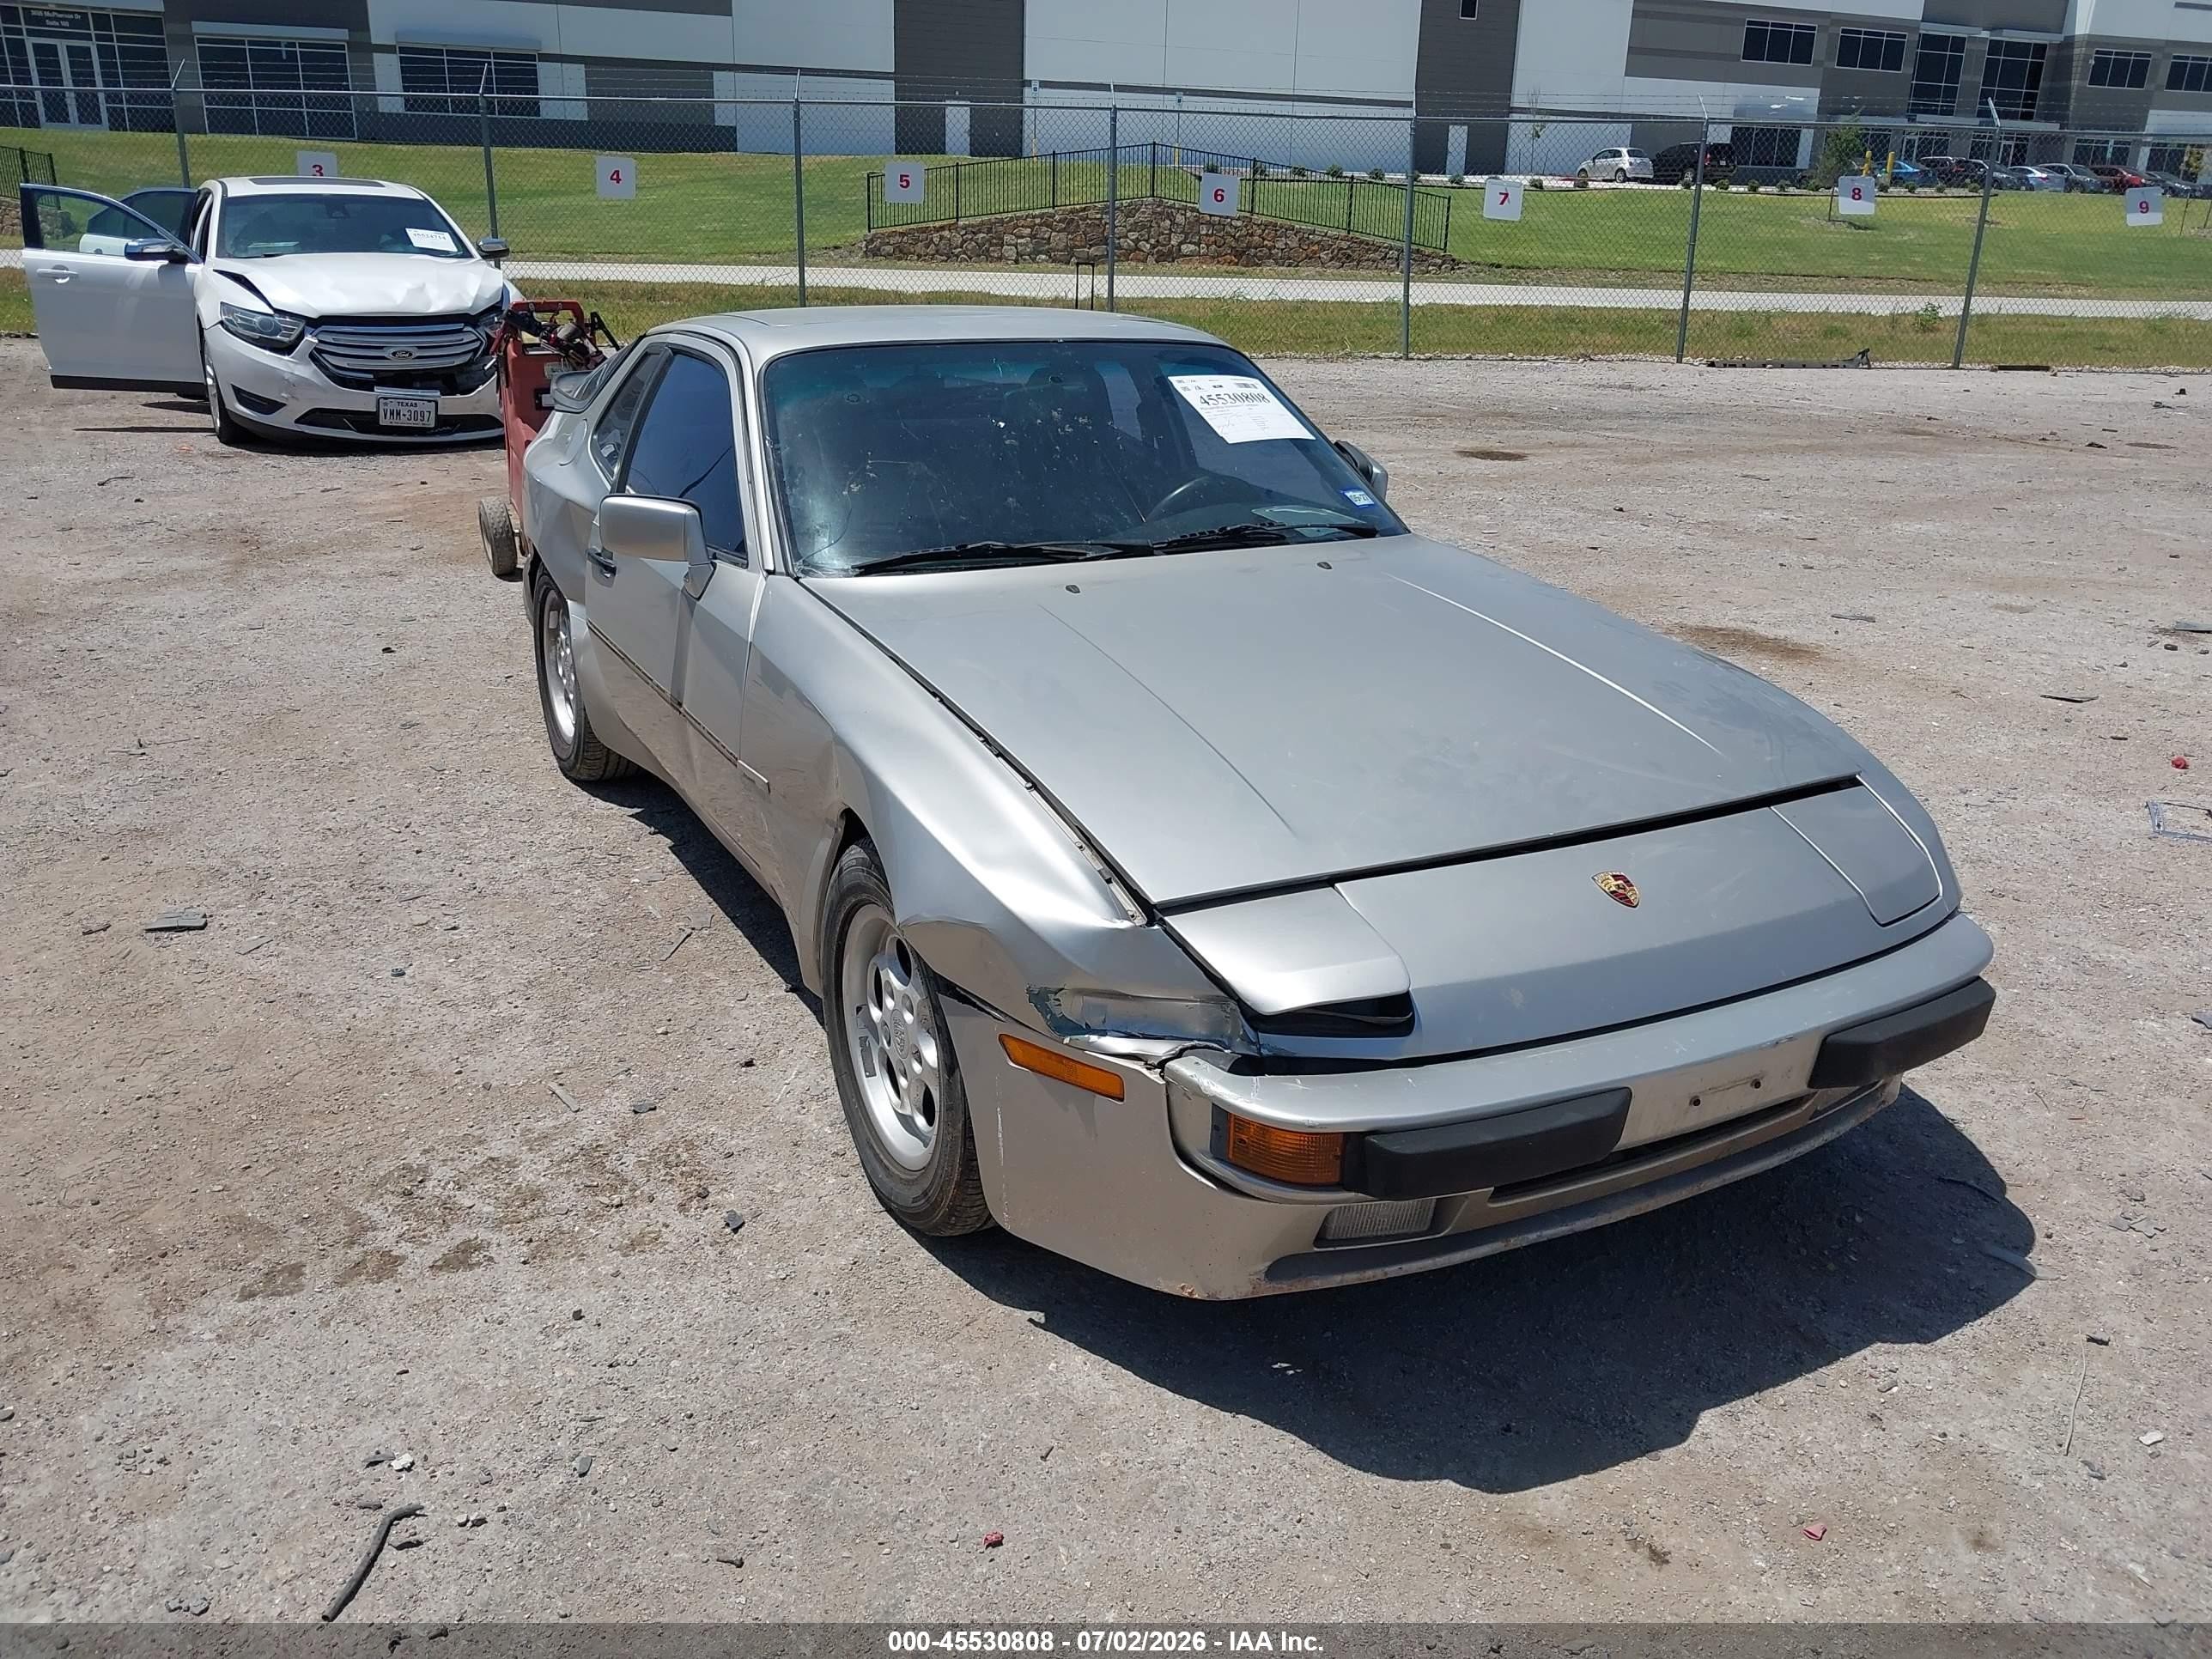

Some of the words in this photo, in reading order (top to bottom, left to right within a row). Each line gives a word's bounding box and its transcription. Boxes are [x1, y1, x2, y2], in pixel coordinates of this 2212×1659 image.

[312, 164, 324, 176] 3
[610, 170, 622, 184] 4
[899, 174, 910, 188] 5
[1213, 188, 1225, 202] 6
[1498, 192, 1510, 205] 7
[1851, 187, 1863, 200] 8
[2139, 201, 2149, 214] 9
[1200, 392, 1270, 406] 45530808
